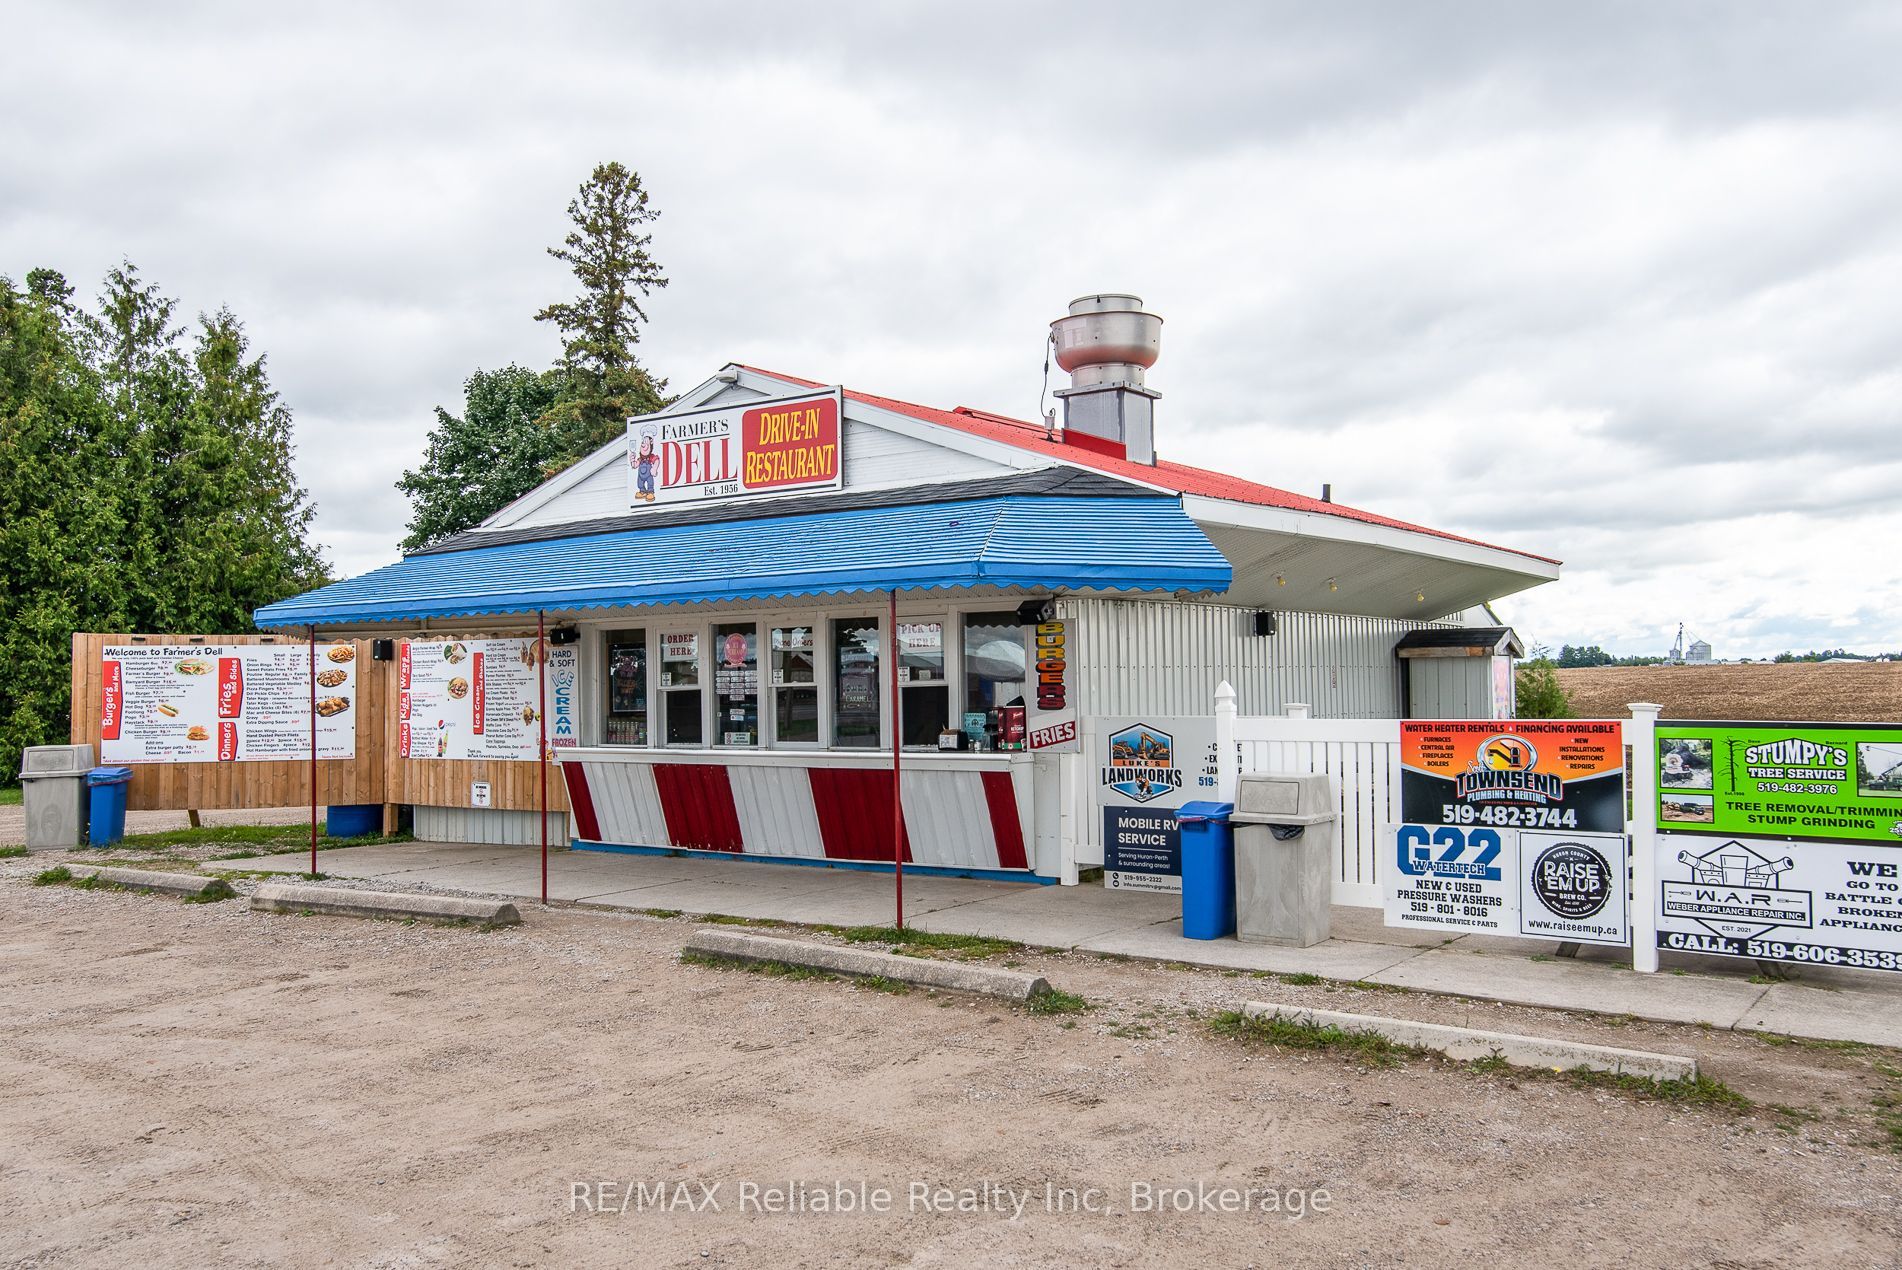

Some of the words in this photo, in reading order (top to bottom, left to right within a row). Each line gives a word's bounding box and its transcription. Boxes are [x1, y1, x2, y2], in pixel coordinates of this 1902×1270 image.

[662, 419, 728, 440] FARMER'S
[759, 408, 820, 446] DRIVE-IN
[660, 438, 738, 487] DELL
[746, 444, 834, 484] RESTAURANT
[704, 486, 718, 496] Est.
[720, 484, 738, 494] 1956
[901, 624, 924, 634] PICK
[928, 624, 941, 632] UP
[668, 634, 694, 643] ORDER
[909, 638, 935, 647] HERE
[104, 648, 147, 656] Welcome
[150, 648, 160, 656] to
[163, 647, 201, 656] Farmer's
[204, 647, 222, 656] Dell
[552, 650, 572, 658] HARD
[670, 648, 692, 656] HERE
[1036, 622, 1066, 710] BURGERS
[552, 670, 574, 687] ICE
[220, 682, 232, 714] Fries
[102, 687, 116, 726] Burgers
[556, 687, 571, 734] CREAM
[1032, 722, 1075, 747] FRIES
[1516, 725, 1564, 733] FINANCING
[1566, 725, 1614, 733] AVAILABLE
[221, 723, 231, 760] Dinners
[552, 738, 576, 747] FROZEN
[1746, 738, 1847, 766] STUMPY'S
[1102, 768, 1182, 787] LANDWORKS
[1748, 768, 1784, 778] TREE
[1788, 768, 1846, 780] SERVICE
[1456, 771, 1563, 800] TOWNSEND
[1757, 782, 1837, 794] 519-482-3976
[1467, 790, 1505, 802] PLUMBING
[1507, 790, 1513, 799] &
[1515, 790, 1546, 804] HEATING
[1726, 802, 1761, 811] TREE
[1442, 804, 1577, 828] 519-482-3744
[1748, 814, 1797, 825] STUMP
[1802, 817, 1875, 829] GRINDING
[1118, 818, 1160, 829] MOBILE
[1164, 820, 1179, 830] RV
[1118, 833, 1166, 845] SERVICE
[1397, 825, 1501, 881] G22
[1553, 850, 1568, 859] HURON
[1570, 850, 1590, 860] COUNTY
[1123, 861, 1153, 869] surrounding
[1413, 861, 1485, 874] WATERTECH
[1544, 861, 1599, 879] RAISE
[1847, 861, 1897, 878] WE
[1416, 880, 1442, 890] NEW
[1455, 882, 1482, 893] USED
[1545, 876, 1573, 890] 'EM
[1576, 878, 1600, 892] UP
[1846, 881, 1870, 889] GO
[1875, 883, 1898, 891] TO
[1397, 890, 1447, 901] PRESSURE
[1450, 894, 1502, 906] WASHERS
[1696, 890, 1771, 906] W.A.R
[1825, 892, 1892, 904] BATTLE
[1411, 902, 1427, 912] 519
[1437, 904, 1454, 914] 801
[1464, 906, 1487, 917] 8016
[1583, 903, 1592, 911] BEER
[1667, 902, 1699, 912] WEBER
[1700, 905, 1749, 916] APPLIANCE
[1751, 910, 1785, 919] REPAIR
[1786, 912, 1804, 920] INC.
[1402, 914, 1444, 923] PROFESSIONAL
[1477, 920, 1498, 928] PARTS
[1529, 921, 1617, 936] www.raiseemup.ca
[1668, 934, 1739, 954] CALL:
